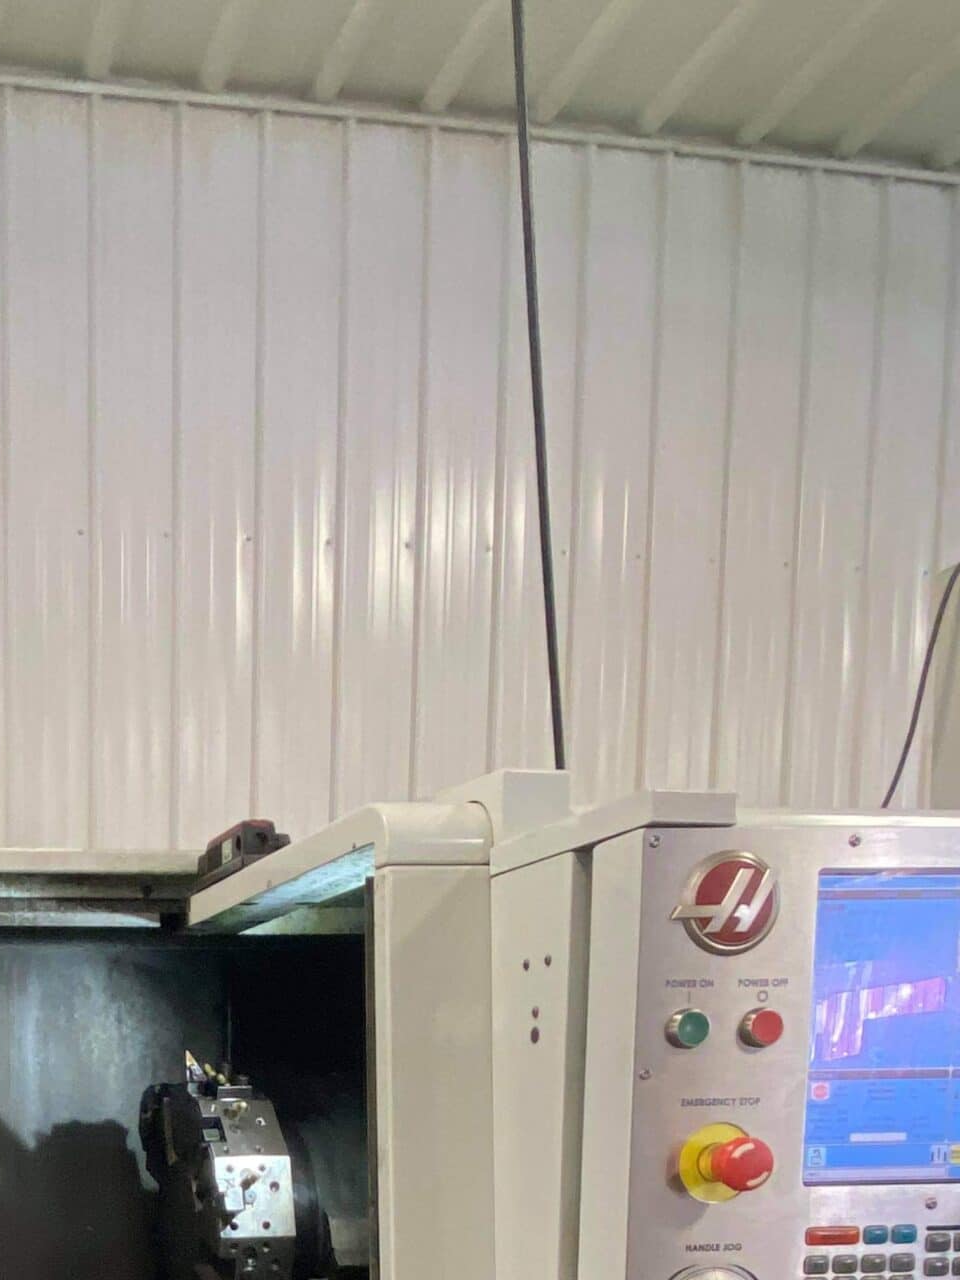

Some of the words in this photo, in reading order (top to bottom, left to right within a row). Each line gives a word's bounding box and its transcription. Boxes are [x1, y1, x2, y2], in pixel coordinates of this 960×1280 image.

[738, 978, 769, 987] POWER
[680, 1097, 736, 1107] EMERGENCY
[685, 1243, 720, 1252] HANDLE
[723, 1243, 742, 1252] JOG
